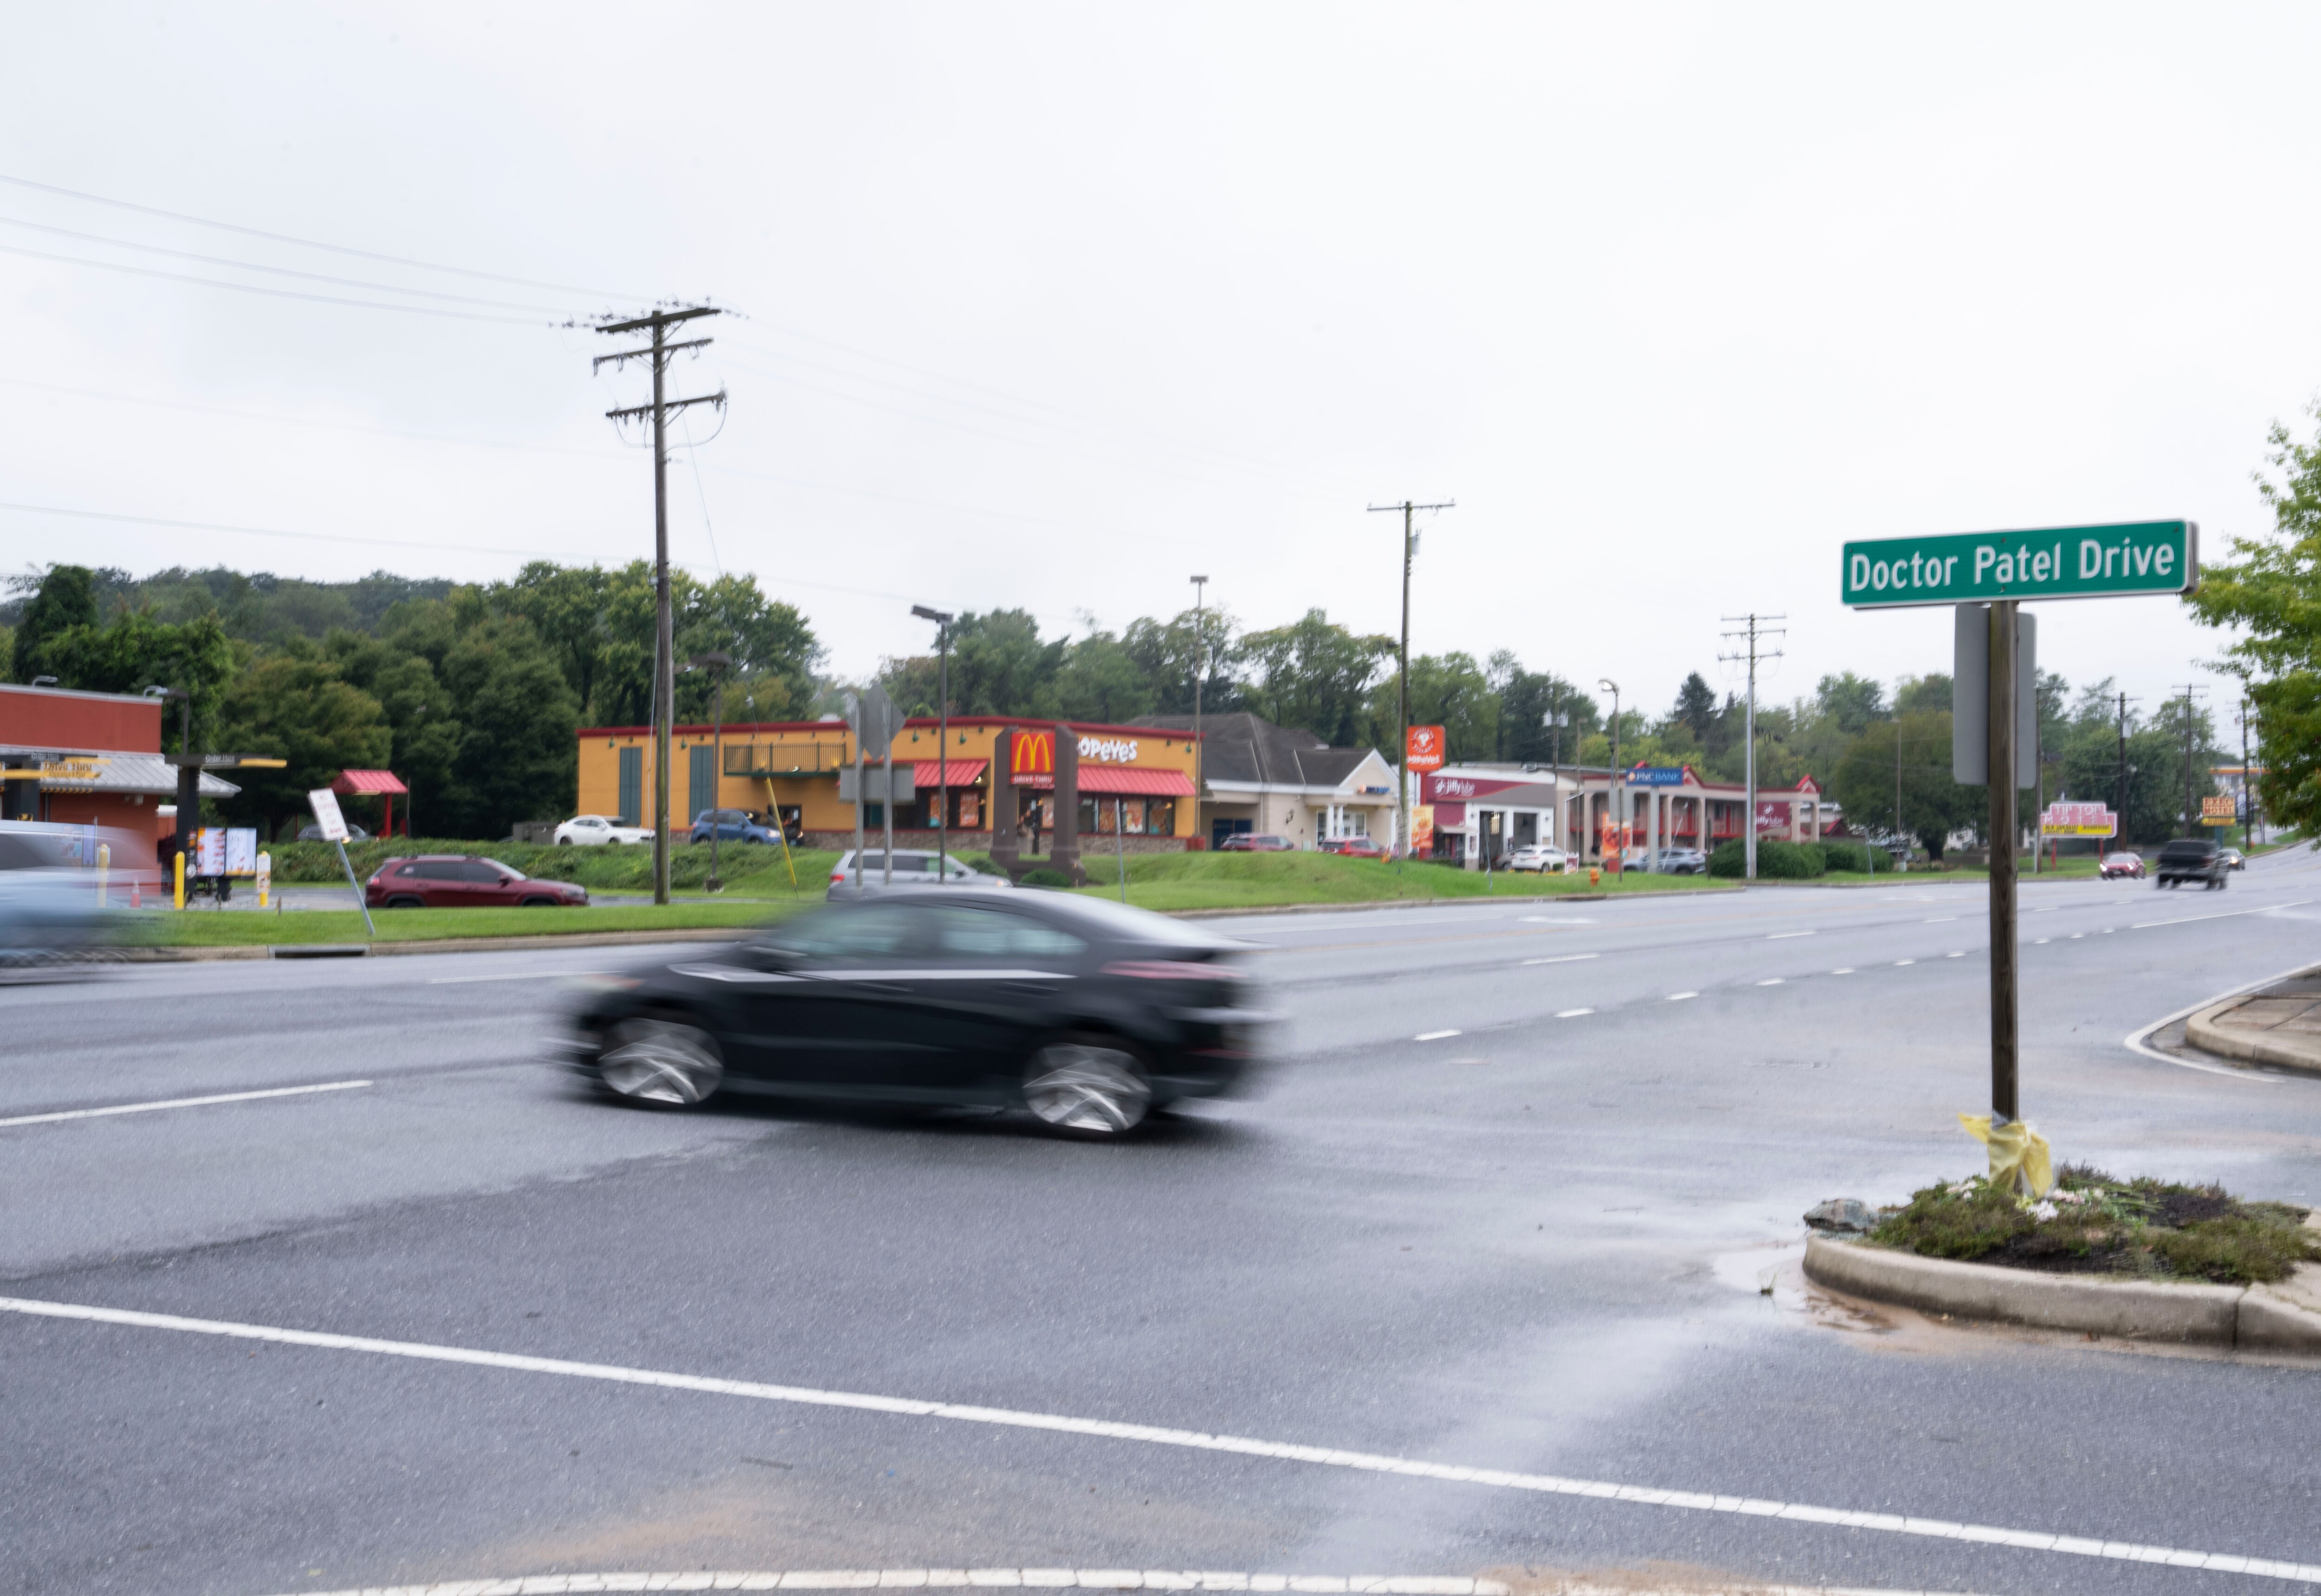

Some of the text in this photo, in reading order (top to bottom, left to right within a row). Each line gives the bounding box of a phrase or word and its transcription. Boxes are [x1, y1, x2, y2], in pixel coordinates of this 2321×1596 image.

[1850, 536, 2175, 591] Doctor Patel Drive
[44, 760, 68, 771] Drive
[1637, 771, 1680, 781] PNC BANK
[2204, 798, 2234, 807] EXEC
[2052, 805, 2072, 814] TIP
[2044, 815, 2111, 825] MOTEL
